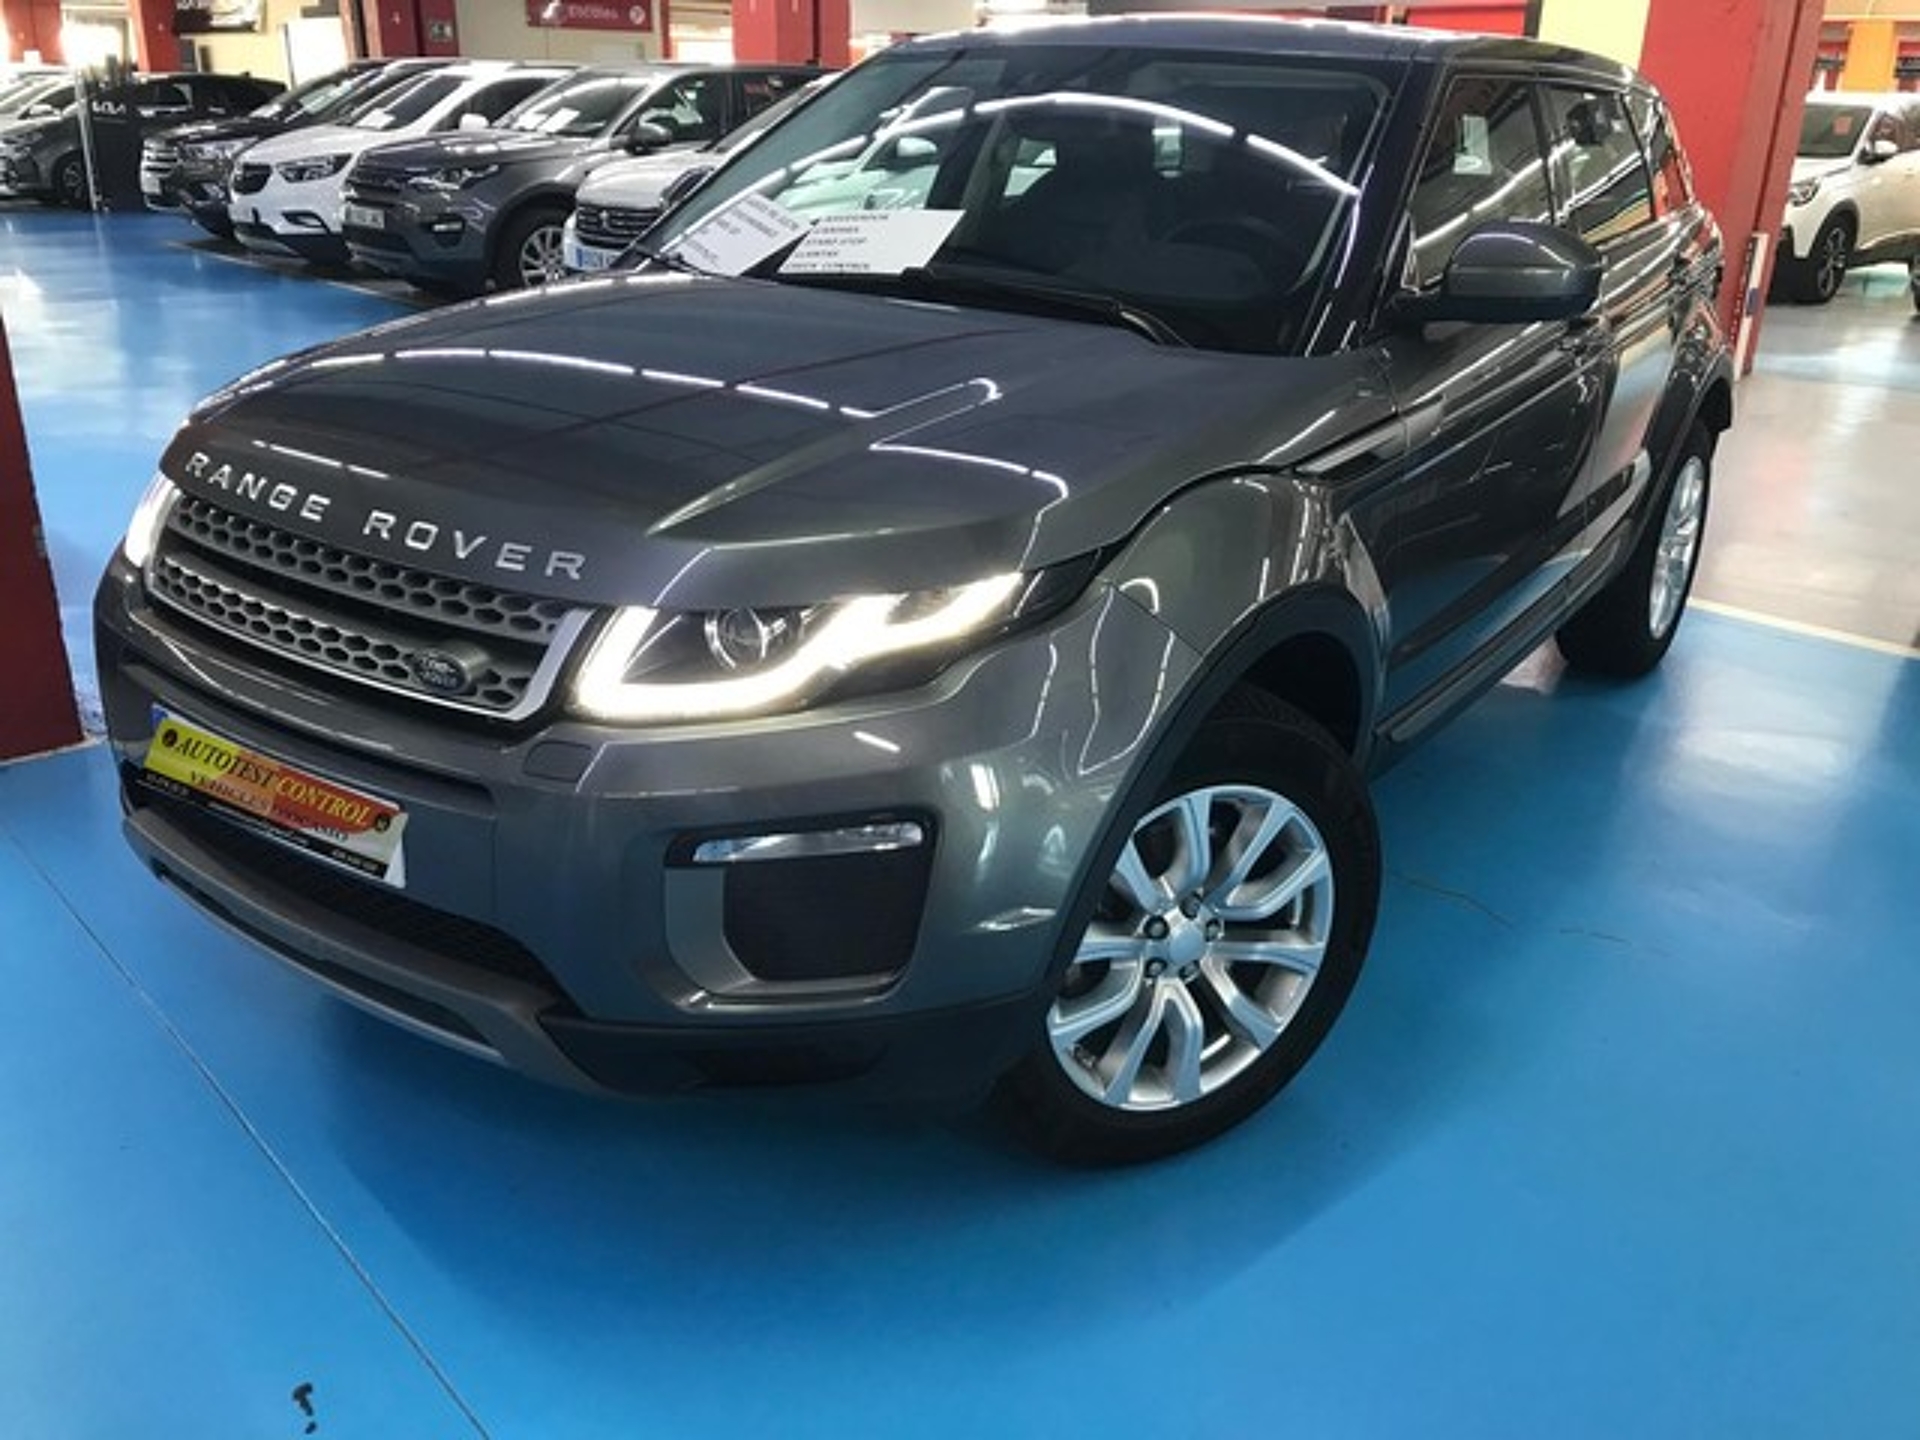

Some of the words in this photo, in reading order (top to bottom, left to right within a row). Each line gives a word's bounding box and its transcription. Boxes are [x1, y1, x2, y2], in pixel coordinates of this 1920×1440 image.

[185, 451, 331, 522] RANGE
[362, 509, 587, 580] ROVER
[176, 736, 276, 788] AUTOTEST
[275, 776, 371, 827] CONTROL
